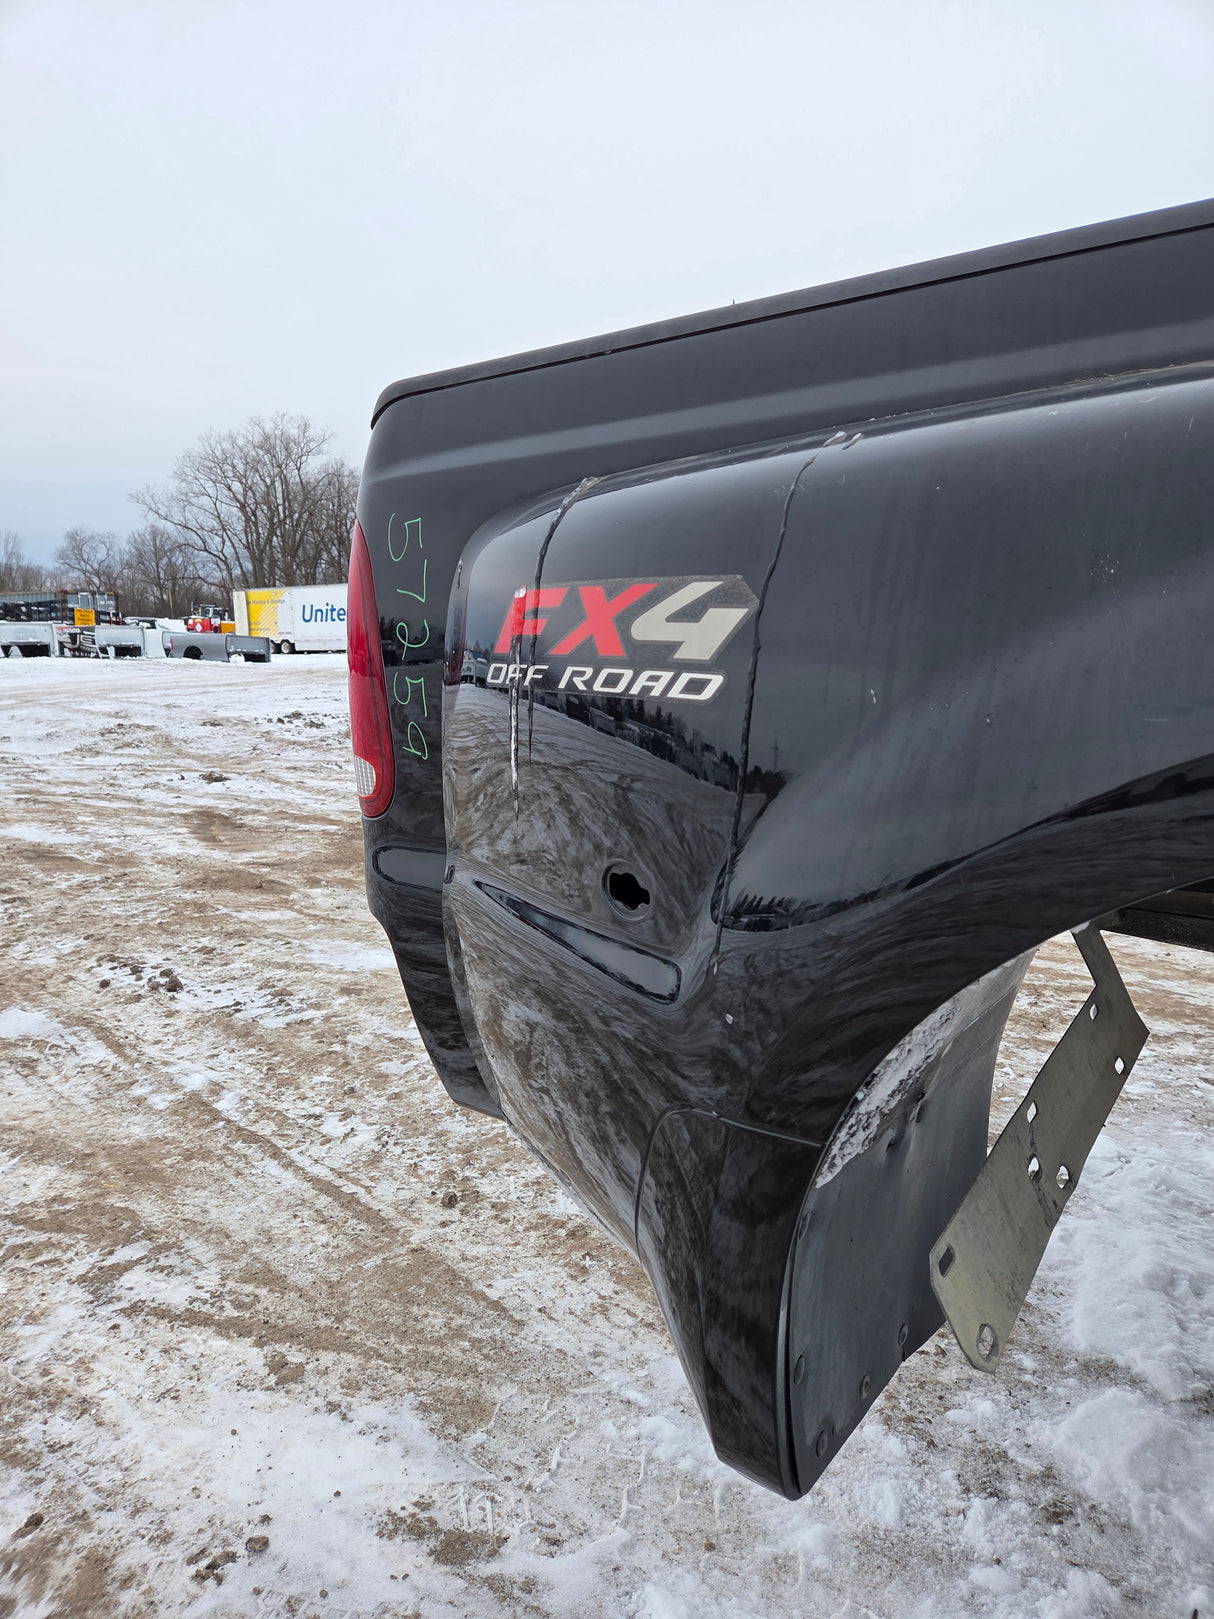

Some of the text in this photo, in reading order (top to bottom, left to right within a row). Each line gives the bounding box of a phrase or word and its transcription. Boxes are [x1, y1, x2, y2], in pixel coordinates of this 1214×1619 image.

[494, 581, 749, 660] FX4
[486, 663, 724, 700] OFF ROAD
